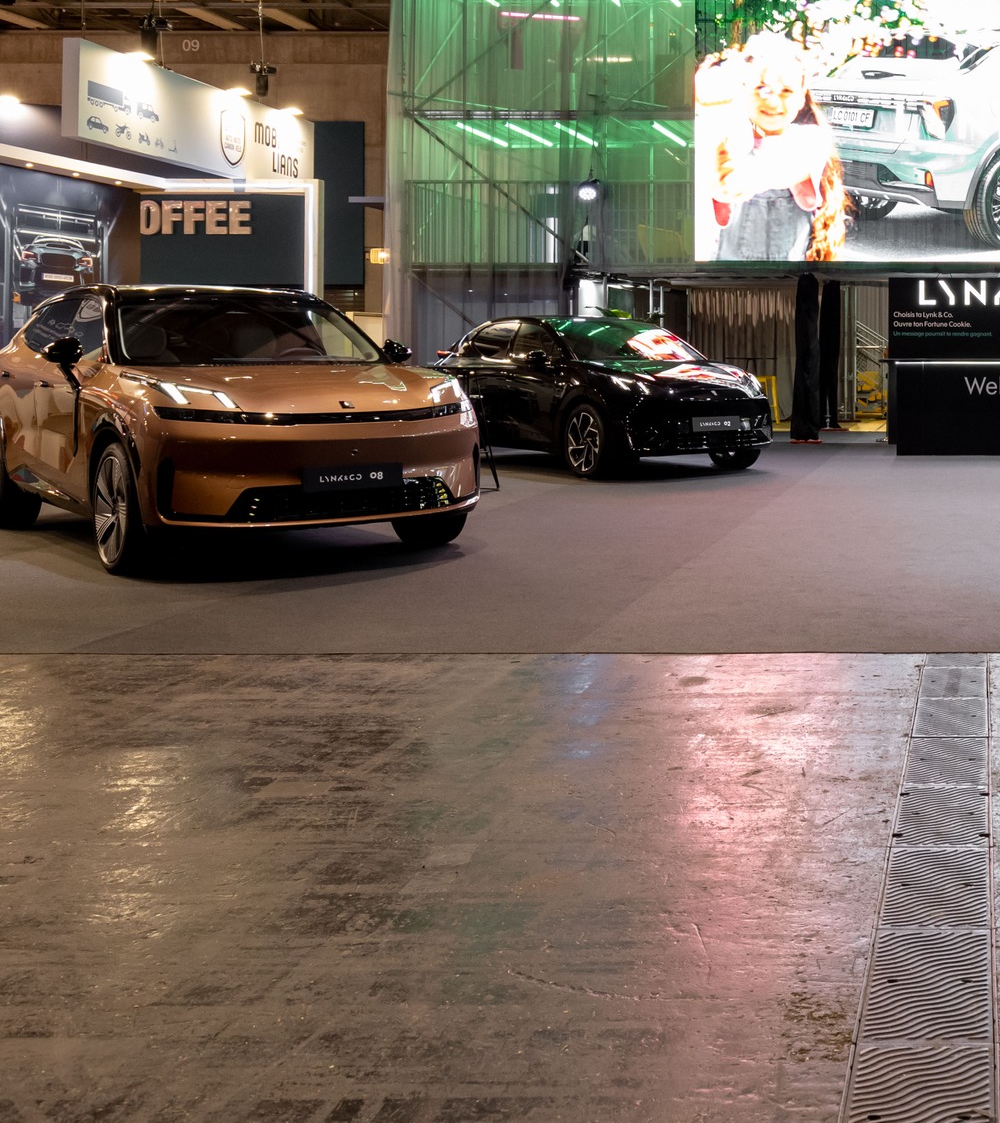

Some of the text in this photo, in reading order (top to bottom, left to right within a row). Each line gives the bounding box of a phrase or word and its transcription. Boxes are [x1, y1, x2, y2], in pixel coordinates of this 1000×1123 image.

[181, 38, 200, 52] 09
[923, 311, 938, 319] Lynk
[893, 320, 972, 328] Ouvre ton Fortune Cookie.
[319, 471, 384, 483] LYNK&CO 08
